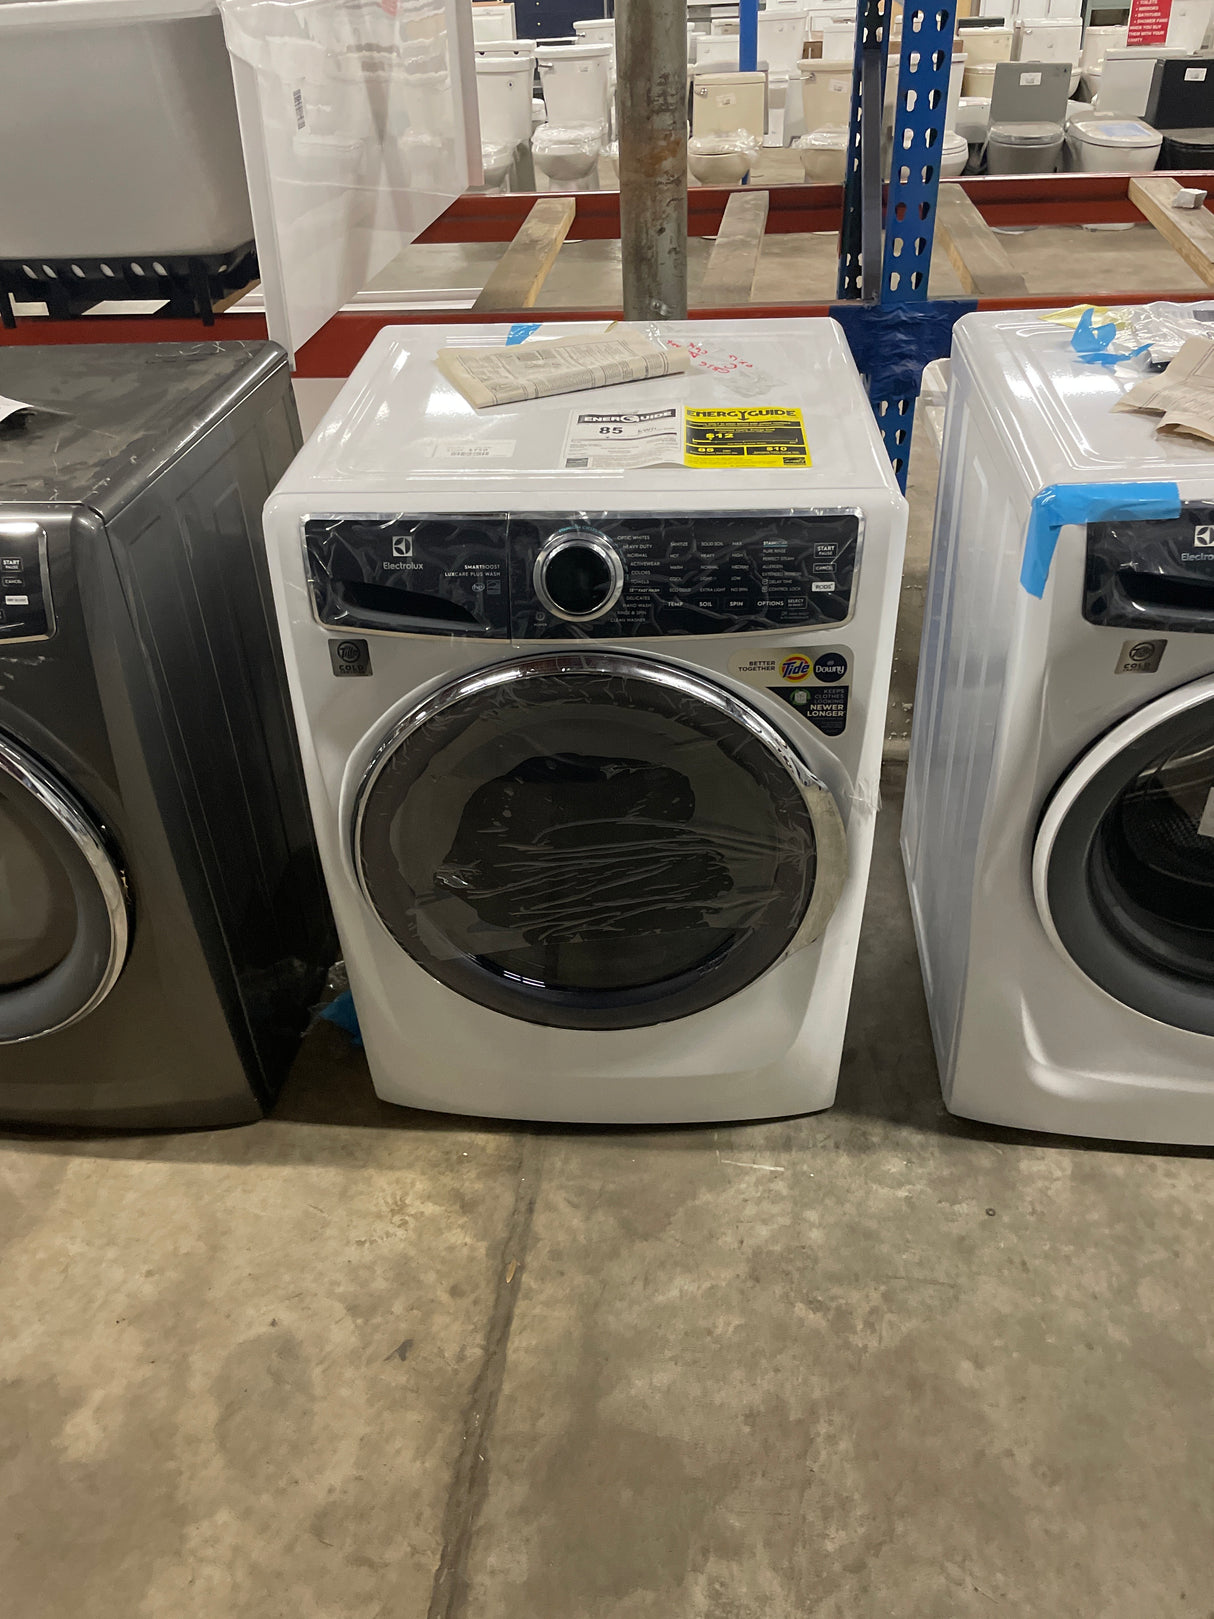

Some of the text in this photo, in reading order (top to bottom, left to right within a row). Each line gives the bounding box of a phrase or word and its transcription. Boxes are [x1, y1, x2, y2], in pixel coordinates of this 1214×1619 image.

[686, 409, 797, 421] ENERGYGUIDE
[599, 426, 623, 434] 85
[383, 561, 424, 570] Electrolux
[782, 660, 810, 678] Tide
[815, 665, 845, 674] Downy
